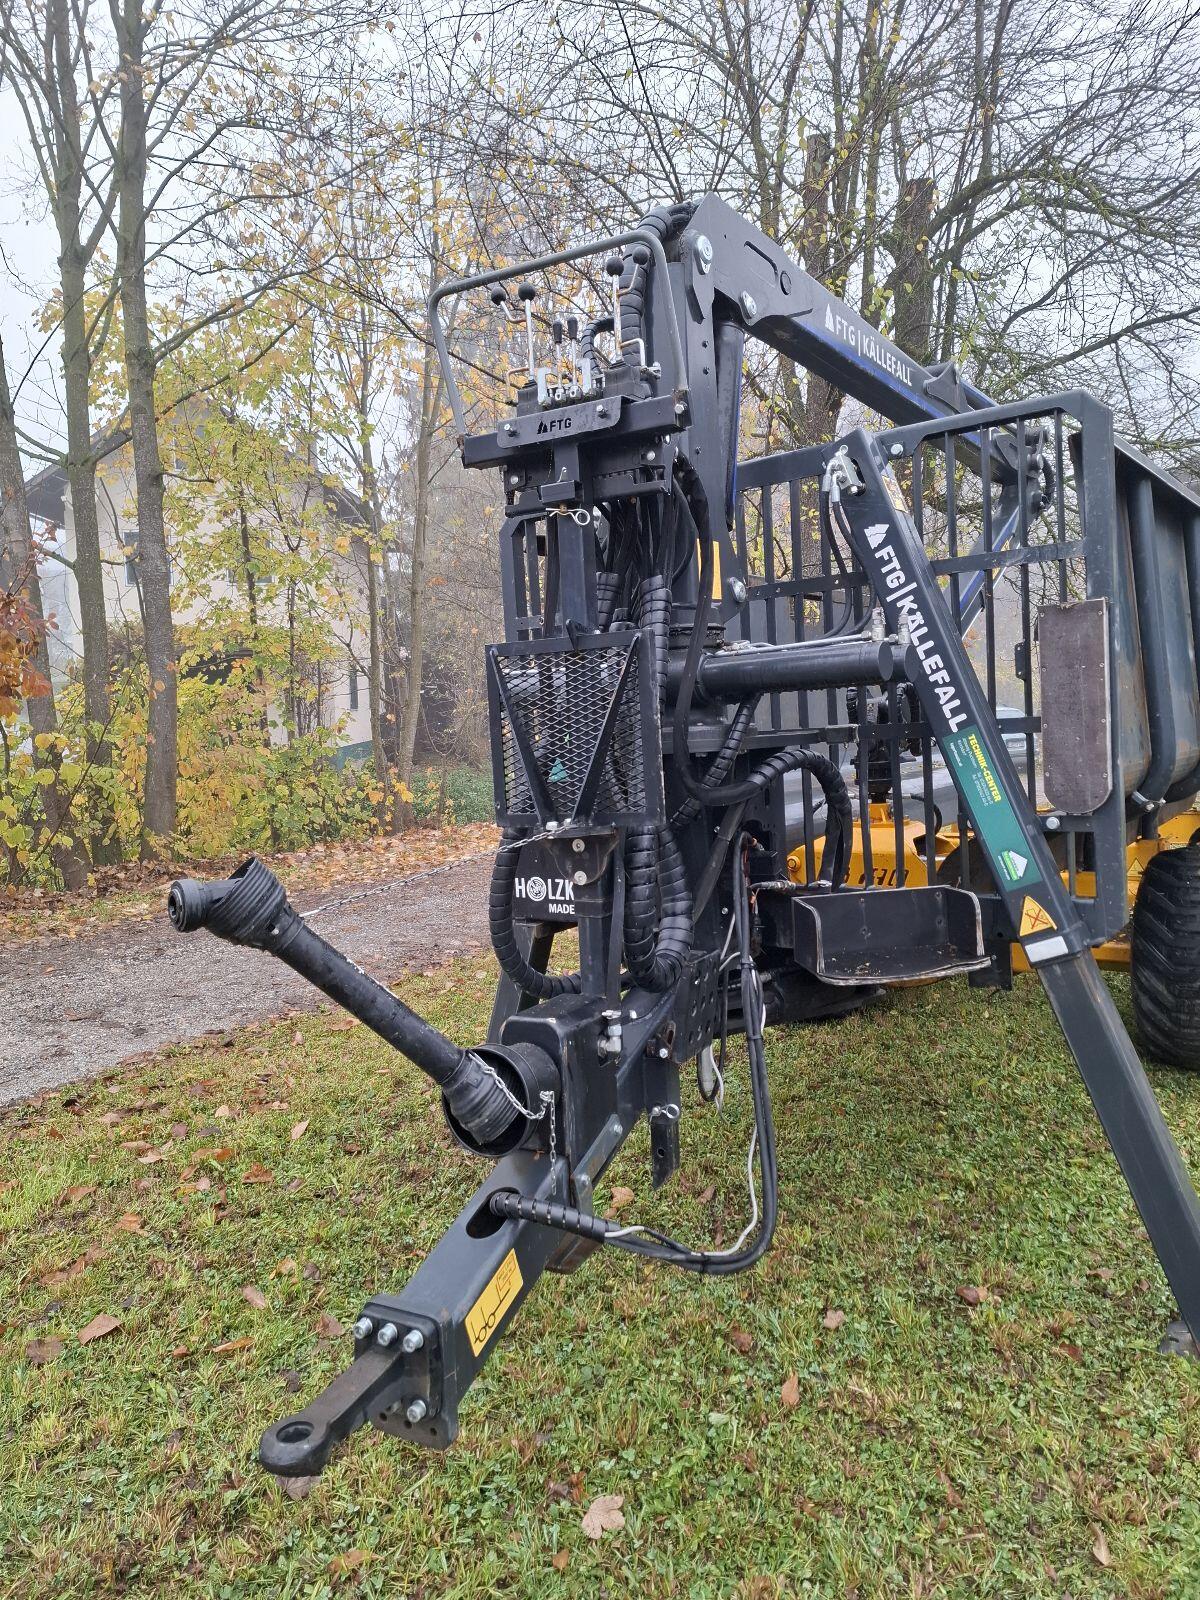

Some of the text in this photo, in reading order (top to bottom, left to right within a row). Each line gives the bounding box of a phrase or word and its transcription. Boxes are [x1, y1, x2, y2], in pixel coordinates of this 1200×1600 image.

[549, 418, 572, 432] FTG
[968, 733, 1002, 803] TECHNIK-CENTER
[549, 903, 576, 915] MADE
